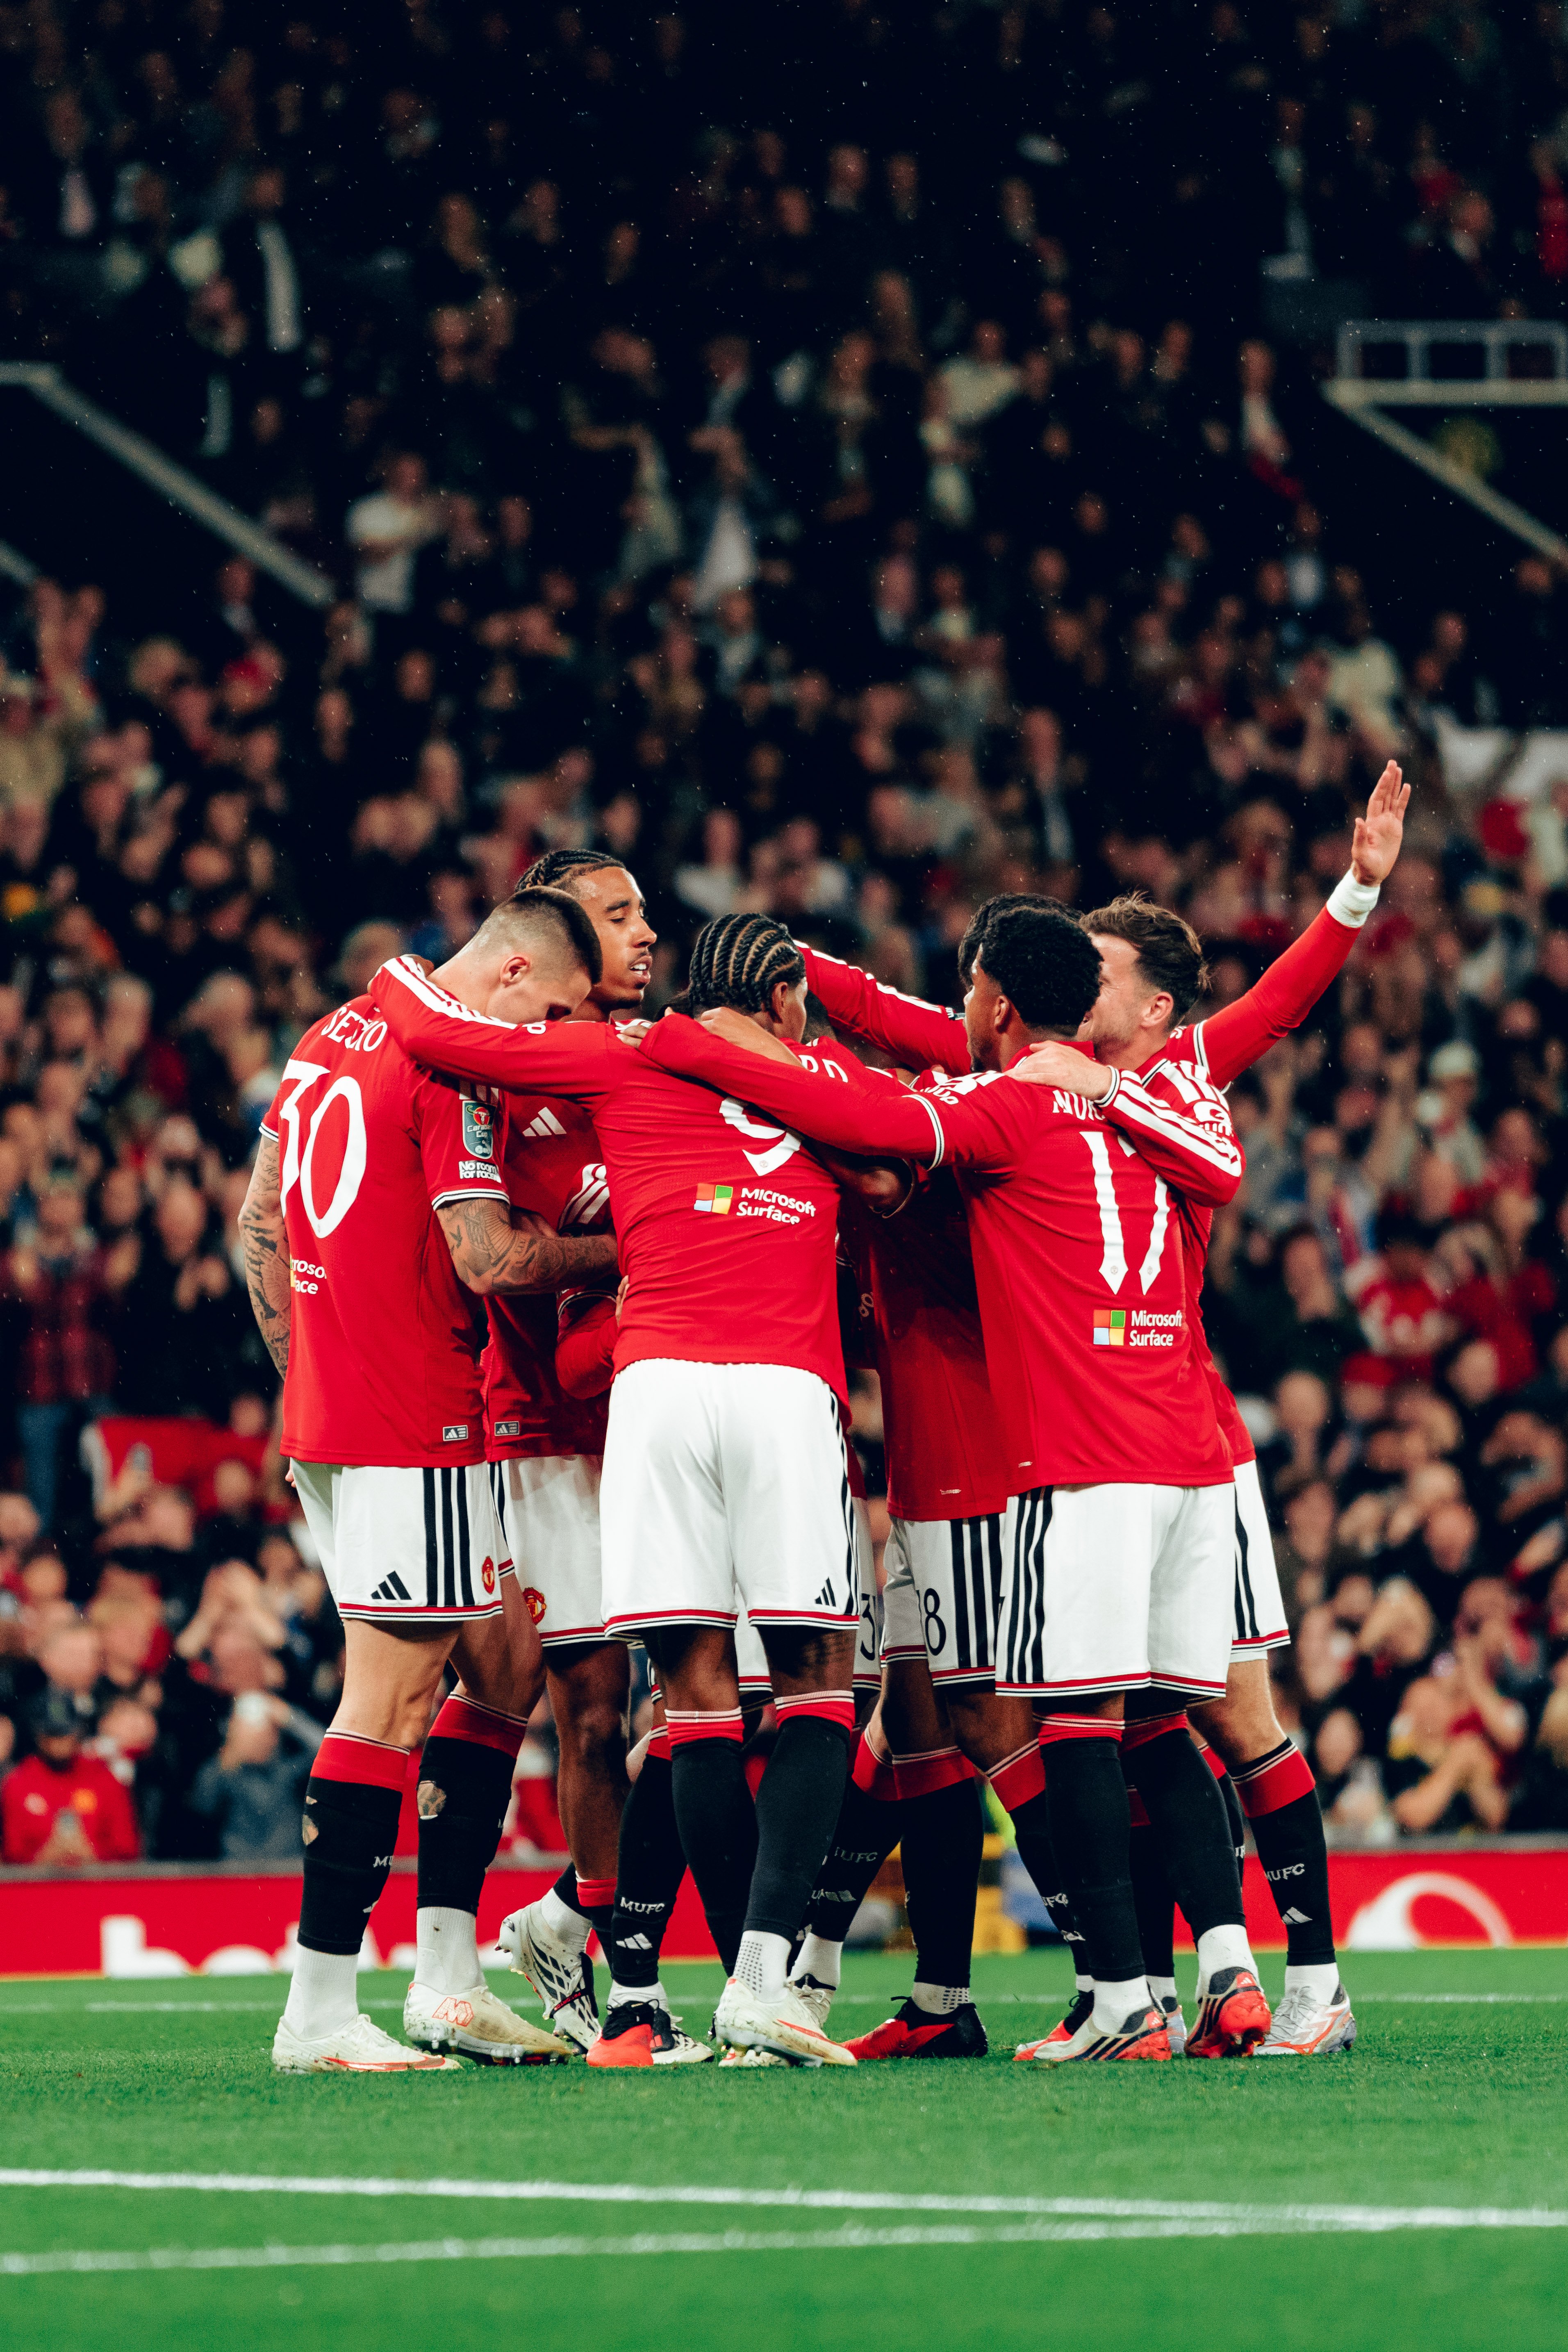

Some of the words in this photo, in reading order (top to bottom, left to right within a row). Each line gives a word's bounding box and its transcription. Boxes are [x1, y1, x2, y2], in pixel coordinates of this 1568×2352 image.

[280, 1059, 367, 1239] 30
[459, 1161, 476, 1171] No
[476, 1162, 497, 1174] room
[460, 1169, 476, 1179] for
[741, 1187, 816, 1217] Microsoft
[736, 1201, 800, 1225] Surface
[1131, 1309, 1183, 1327] Microsoft
[1129, 1330, 1174, 1347] Surface
[620, 1896, 665, 1914] MUFC
